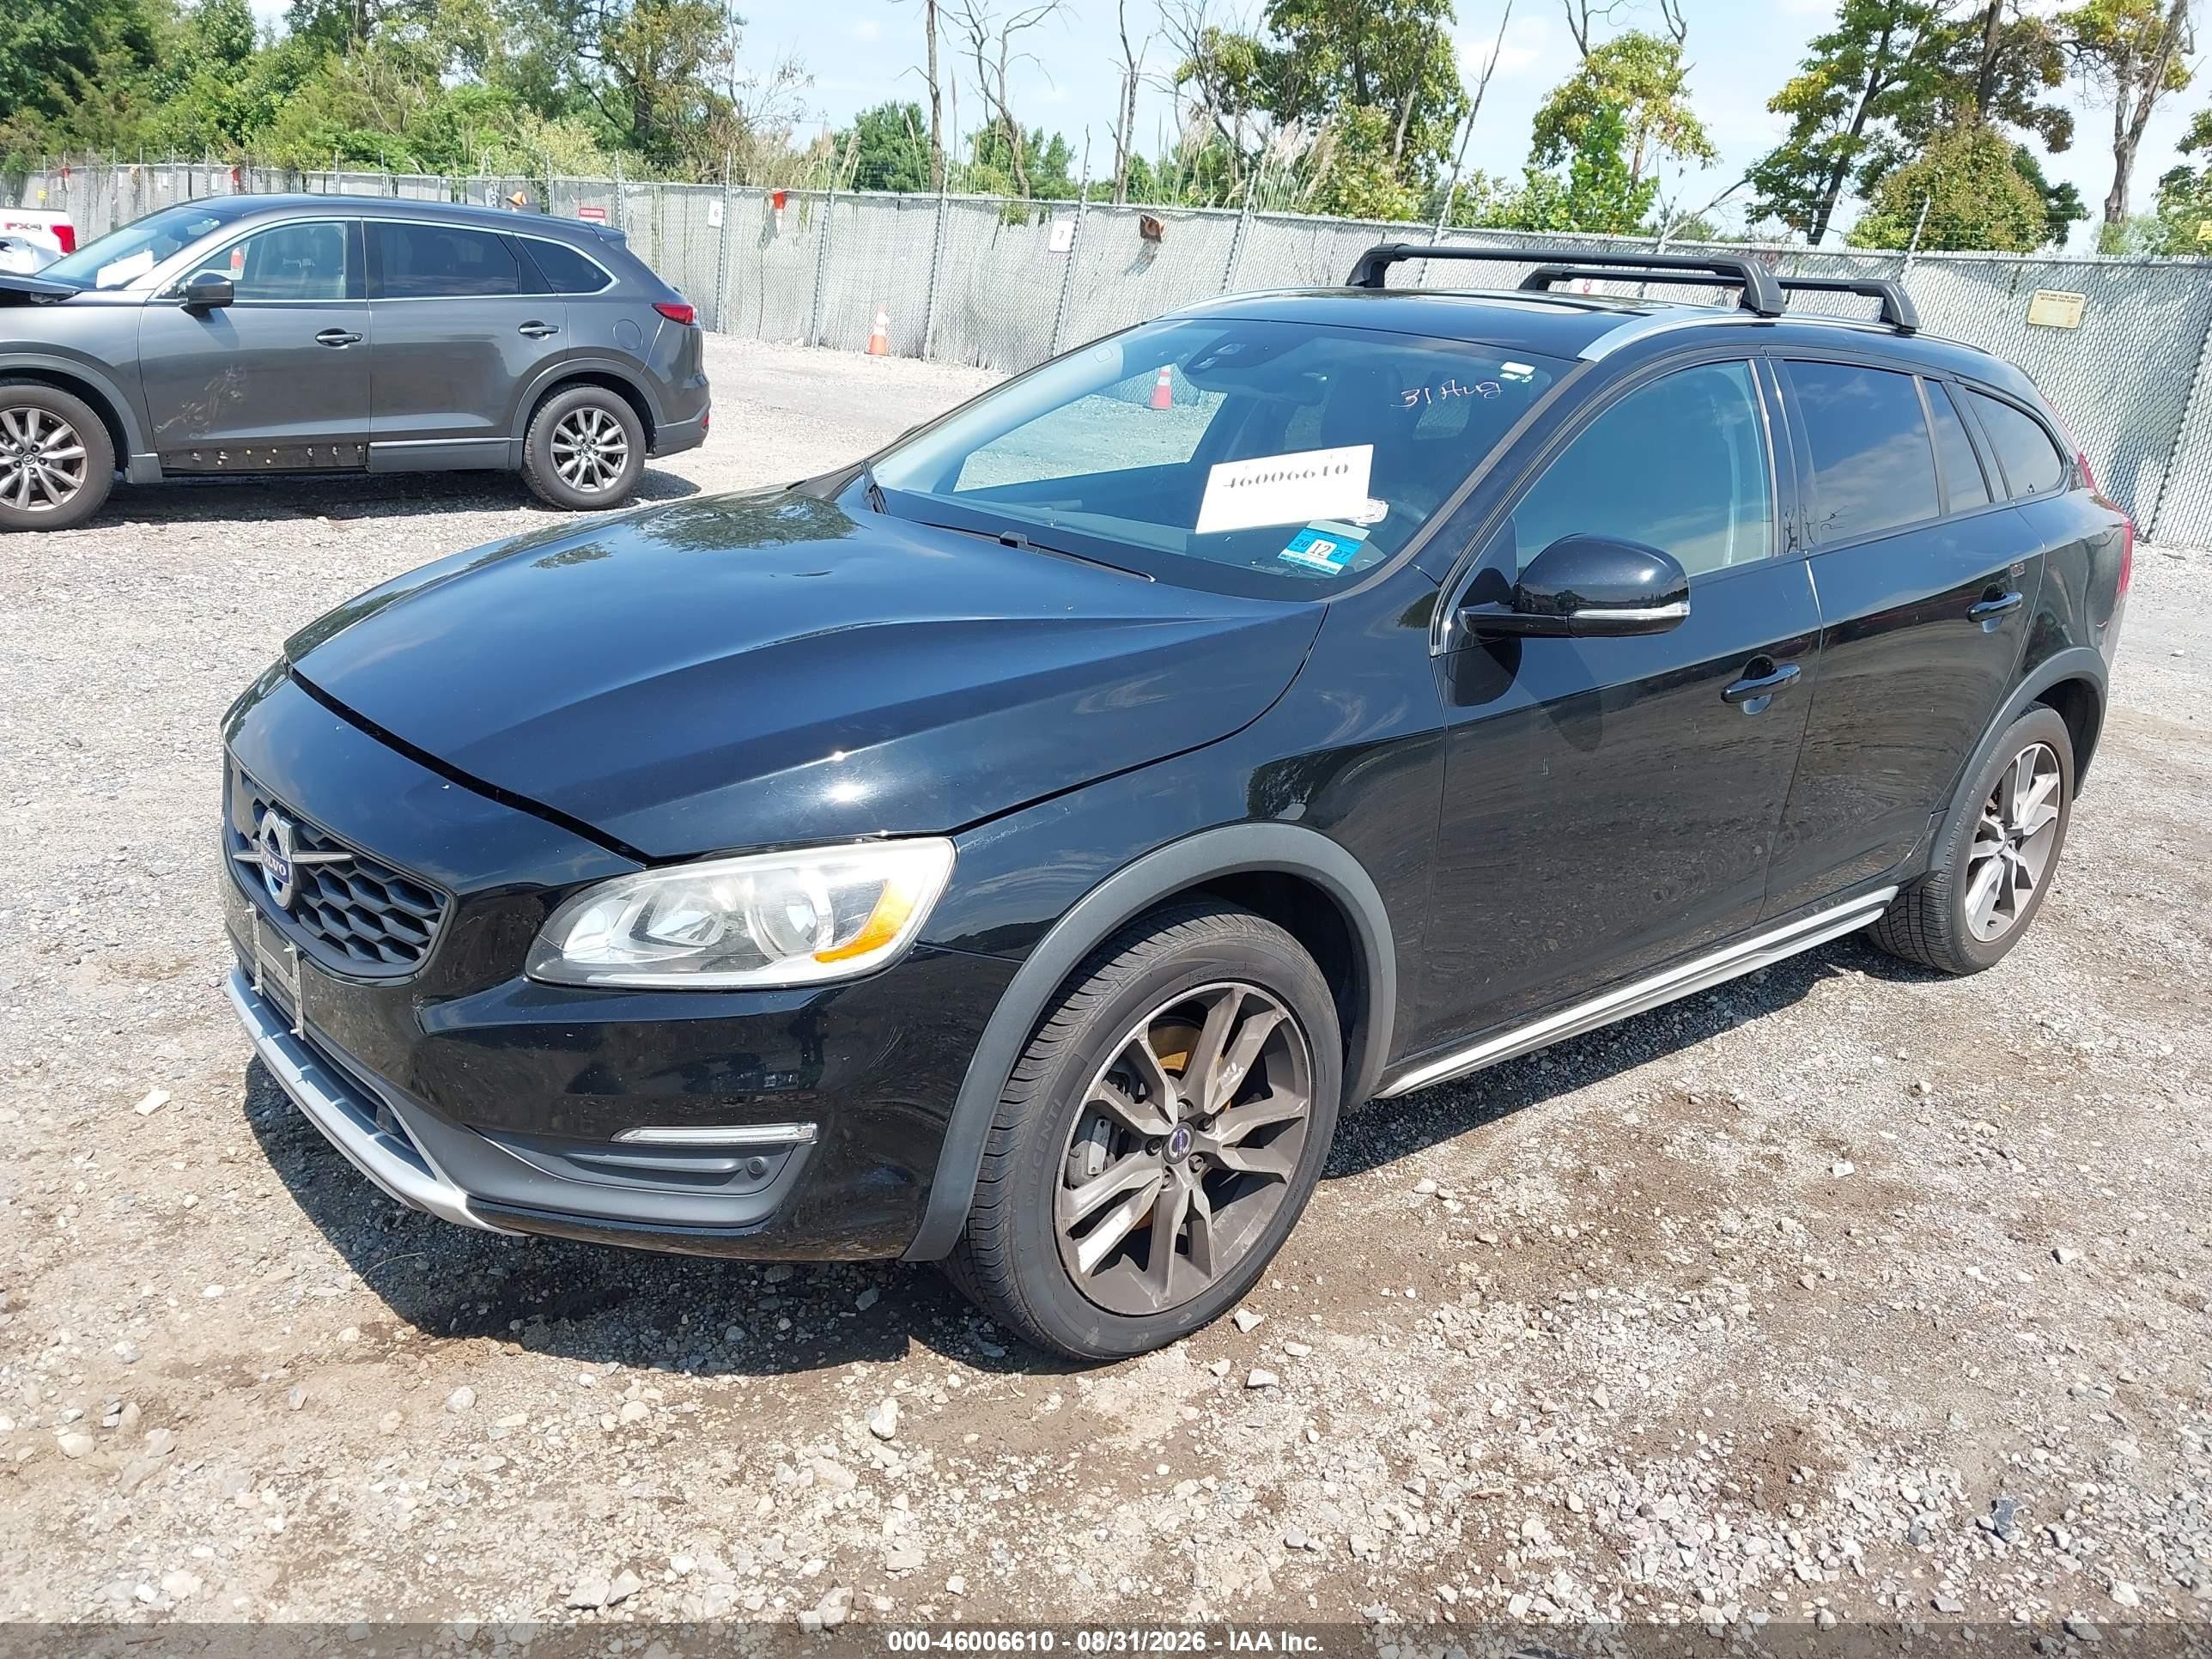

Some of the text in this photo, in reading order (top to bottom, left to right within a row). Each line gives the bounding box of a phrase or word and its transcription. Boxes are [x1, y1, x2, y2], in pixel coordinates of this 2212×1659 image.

[4, 222, 42, 231] FX4
[1389, 379, 1504, 408] 31 Aug
[1223, 463, 1349, 488] 46006610
[1293, 538, 1310, 548] 20
[1310, 543, 1332, 556] 12
[1333, 549, 1351, 559] 27
